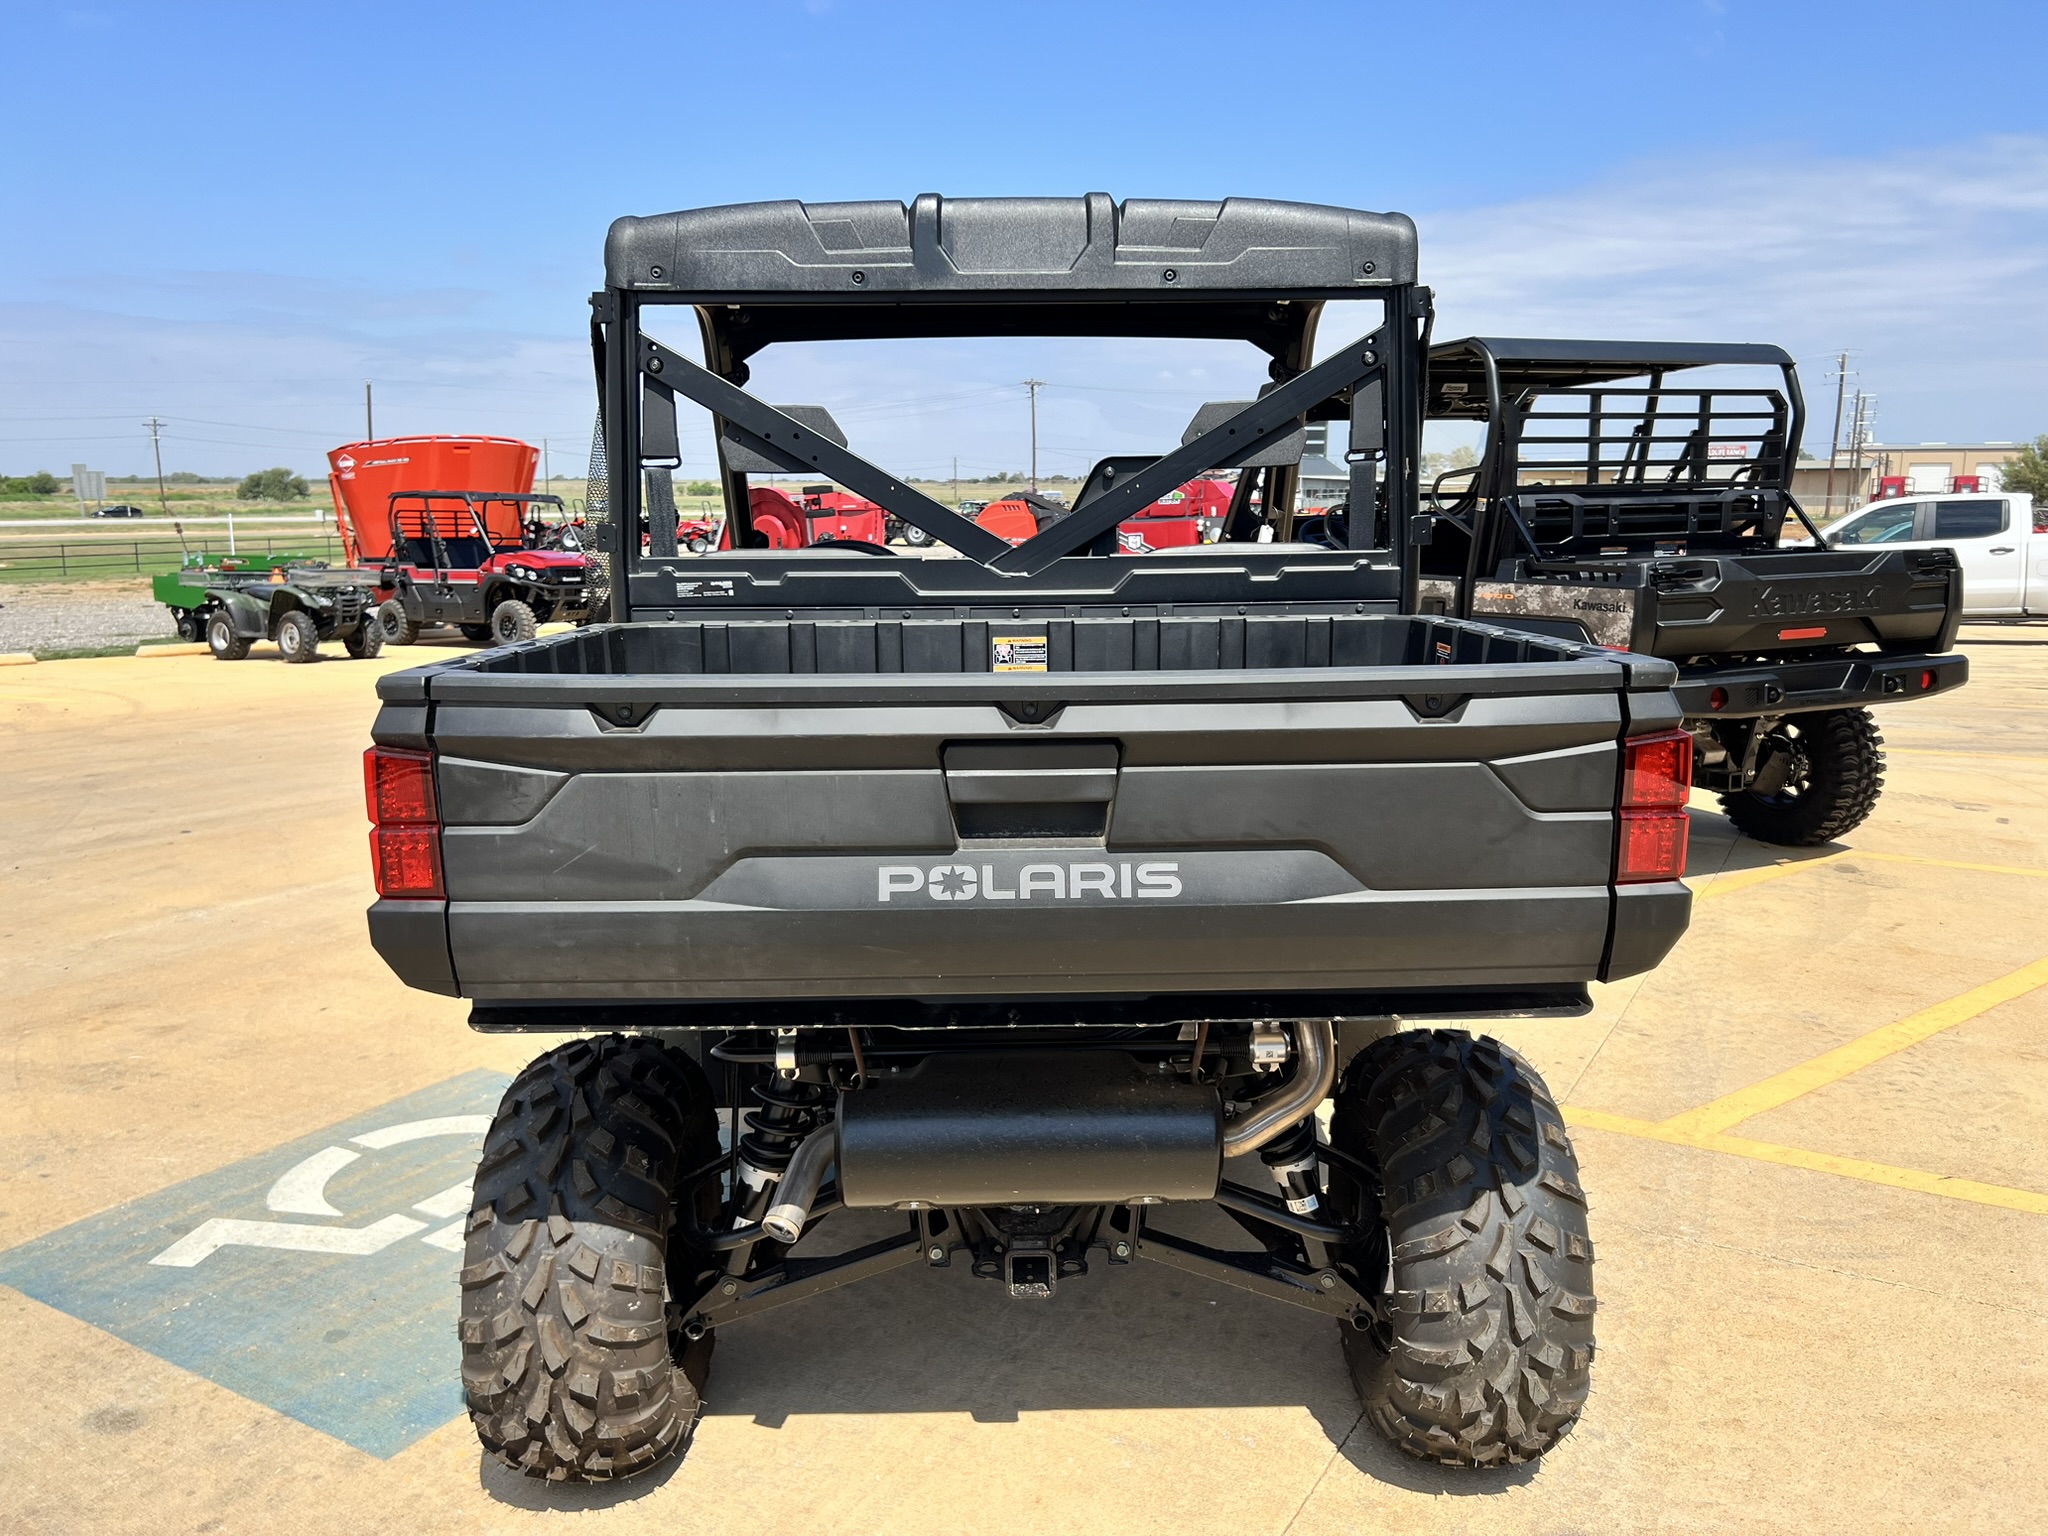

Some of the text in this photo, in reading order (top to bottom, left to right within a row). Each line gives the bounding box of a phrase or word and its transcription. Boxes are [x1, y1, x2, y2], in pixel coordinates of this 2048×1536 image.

[1573, 599, 1626, 613] Kawasaki
[1748, 585, 1882, 617] Kawasaki
[878, 862, 1183, 901] POLARIS
